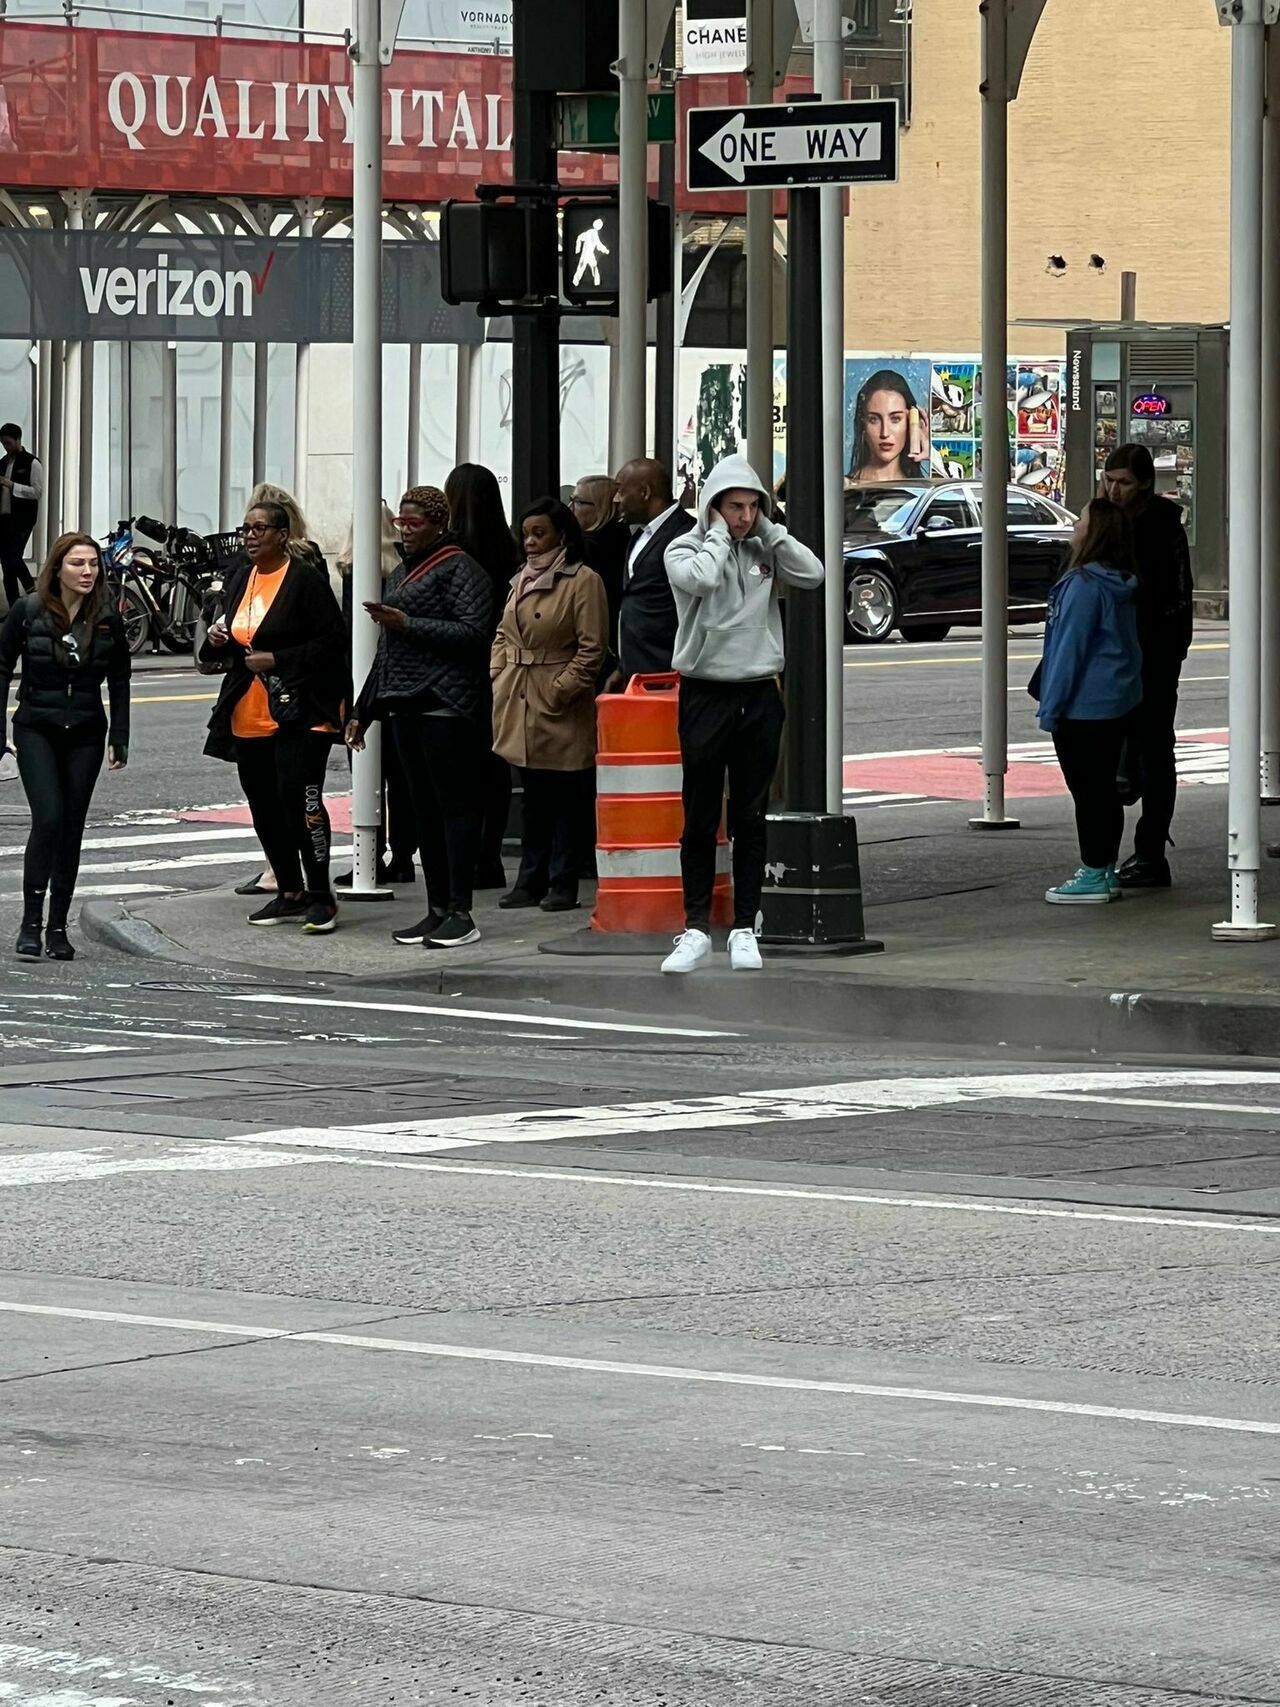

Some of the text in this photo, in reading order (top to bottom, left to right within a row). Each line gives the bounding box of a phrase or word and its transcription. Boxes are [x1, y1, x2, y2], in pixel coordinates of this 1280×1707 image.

[687, 28, 747, 44] CHANE
[720, 127, 868, 163] ONE WAY
[79, 253, 253, 317] verizon
[1073, 350, 1082, 411] Newsstand
[1133, 399, 1166, 413] OPEN
[305, 784, 319, 812] LOUIS
